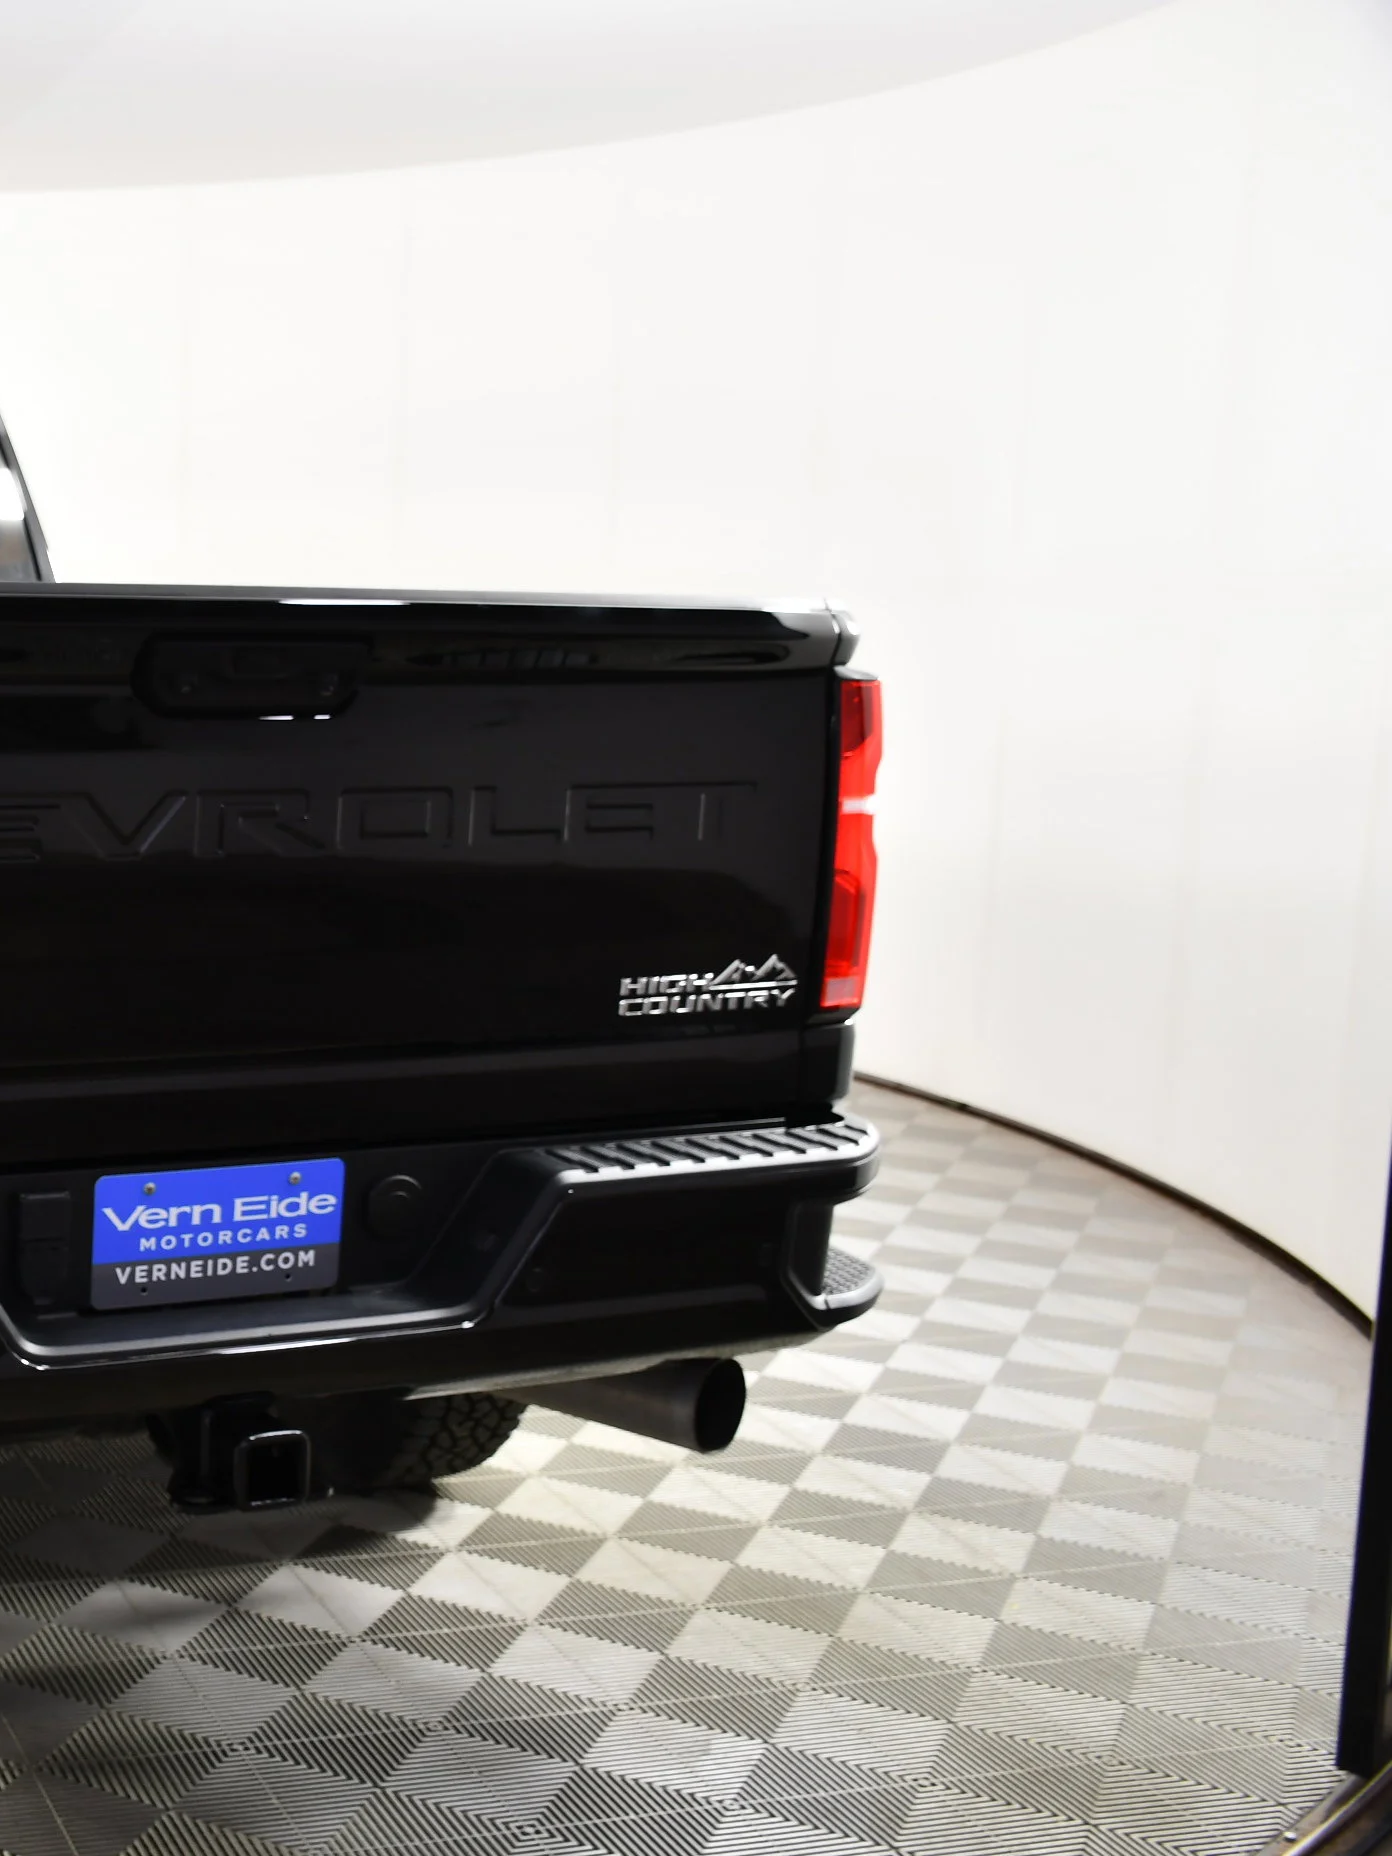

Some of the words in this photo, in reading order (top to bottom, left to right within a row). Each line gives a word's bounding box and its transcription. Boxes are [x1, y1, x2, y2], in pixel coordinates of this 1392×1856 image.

[619, 972, 715, 997] HIGH
[618, 988, 796, 1016] COUNTRY
[102, 1204, 222, 1232] Vern
[232, 1191, 338, 1222] Eide
[139, 1223, 308, 1252] MOTORCARS
[115, 1249, 316, 1285] VERNEIDE.COM
